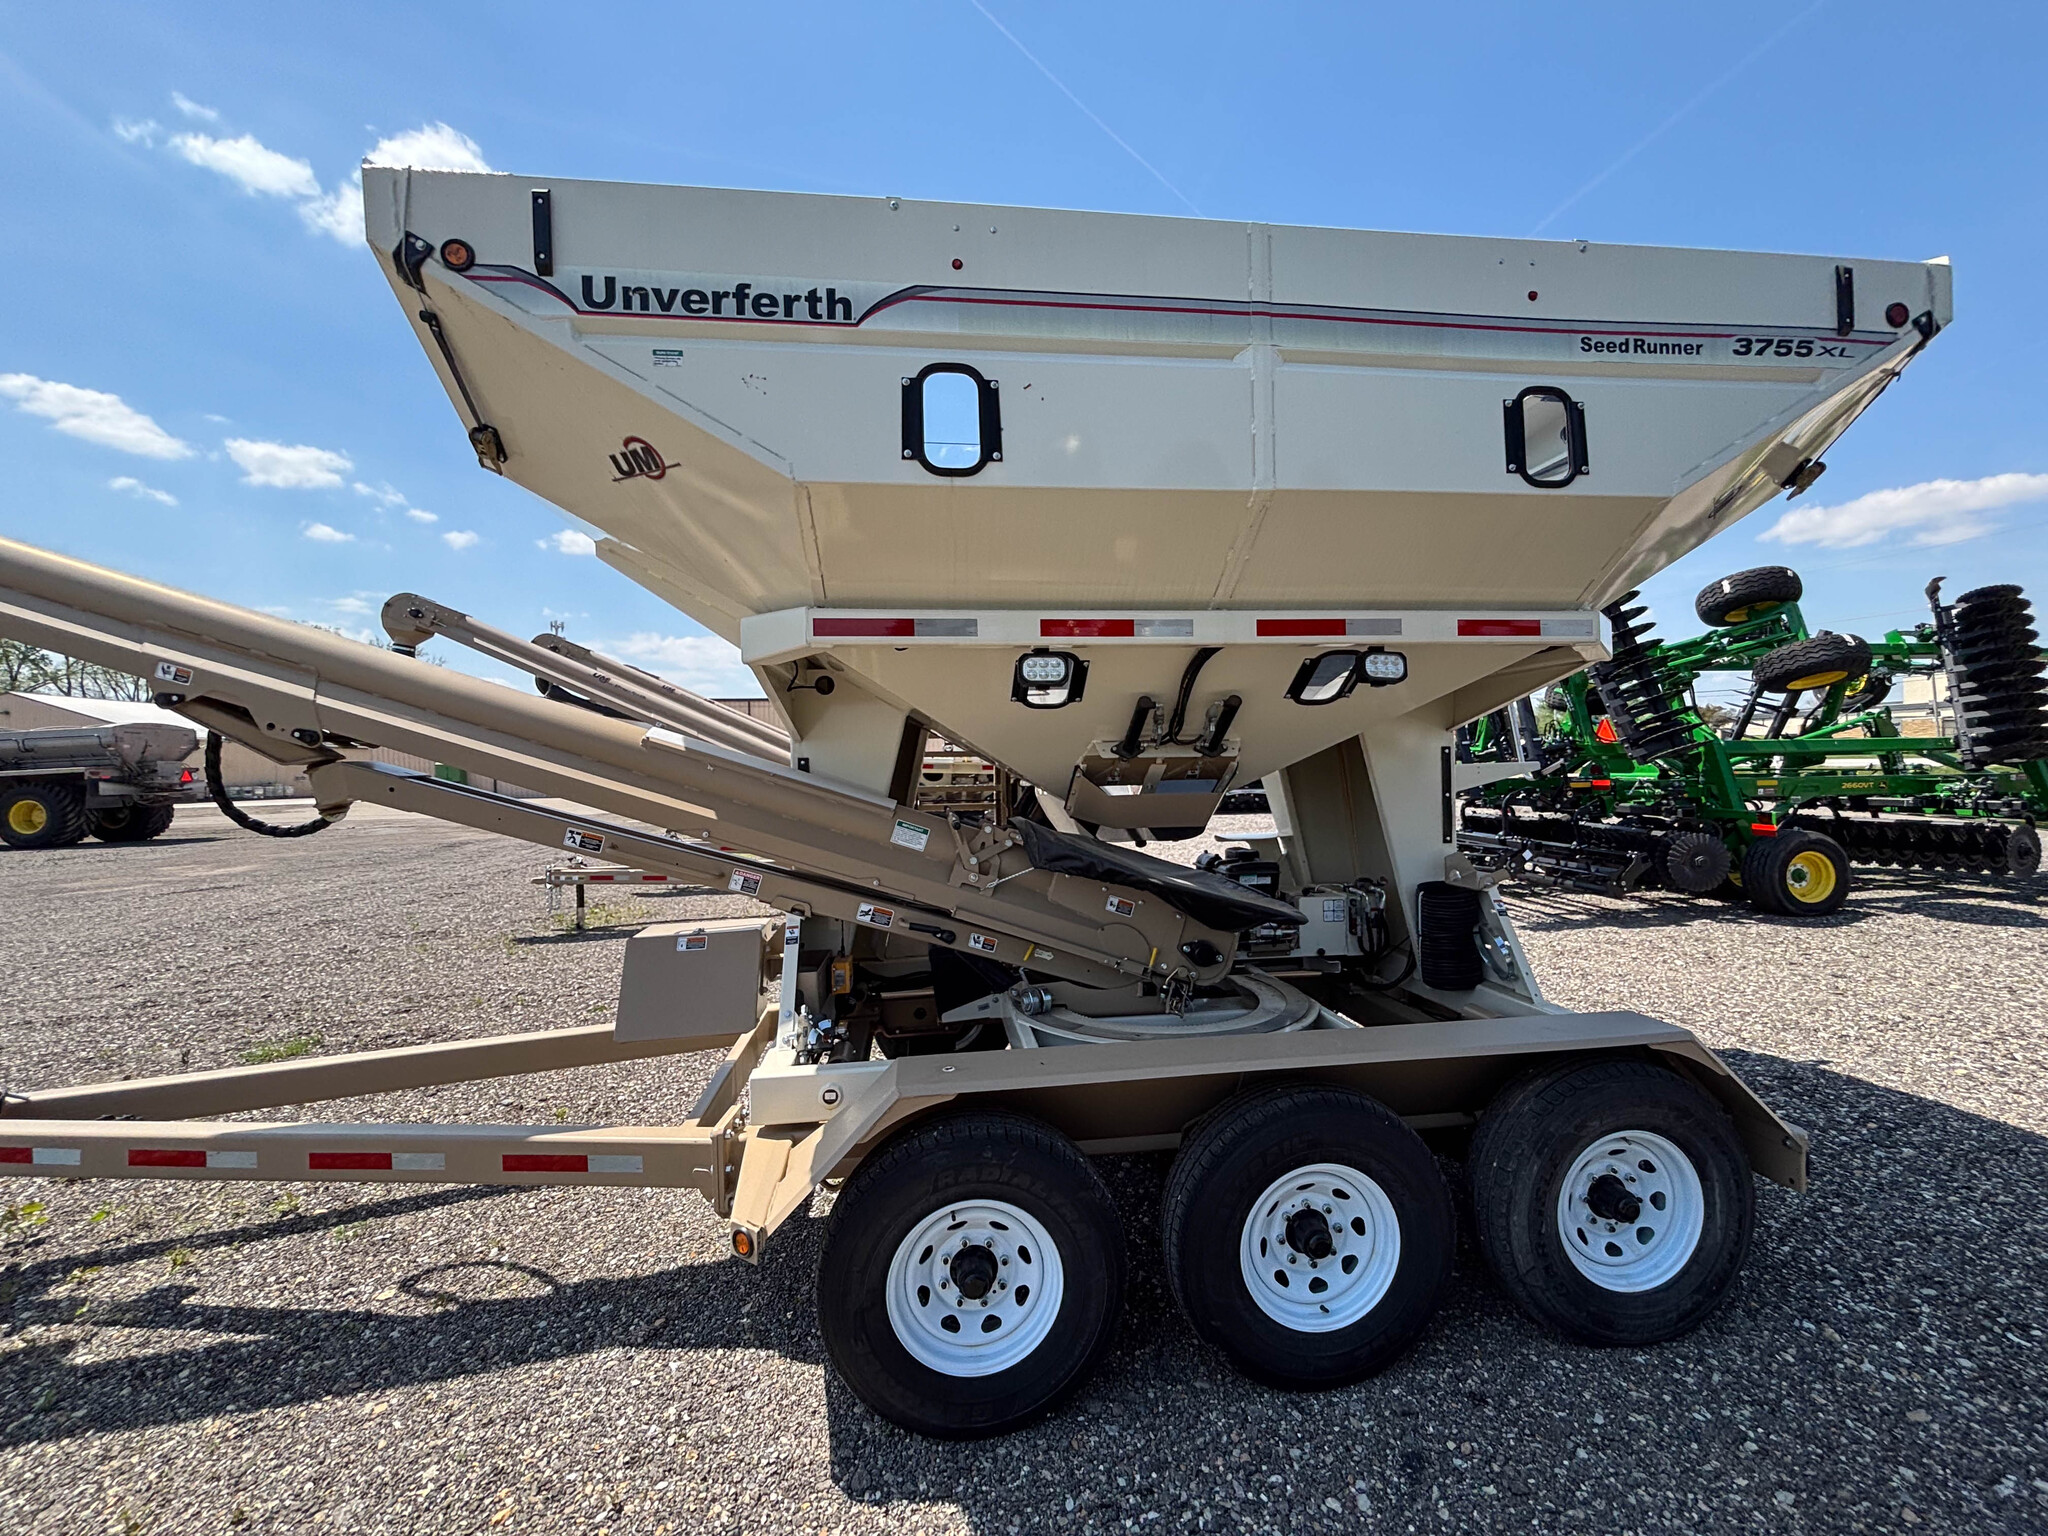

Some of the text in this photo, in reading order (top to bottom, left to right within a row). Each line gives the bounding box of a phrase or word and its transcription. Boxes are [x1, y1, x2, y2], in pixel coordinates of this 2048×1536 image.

[581, 275, 853, 320] Unverferth
[1580, 336, 1703, 356] Seed Runner
[1732, 337, 1856, 358] 3755 XL
